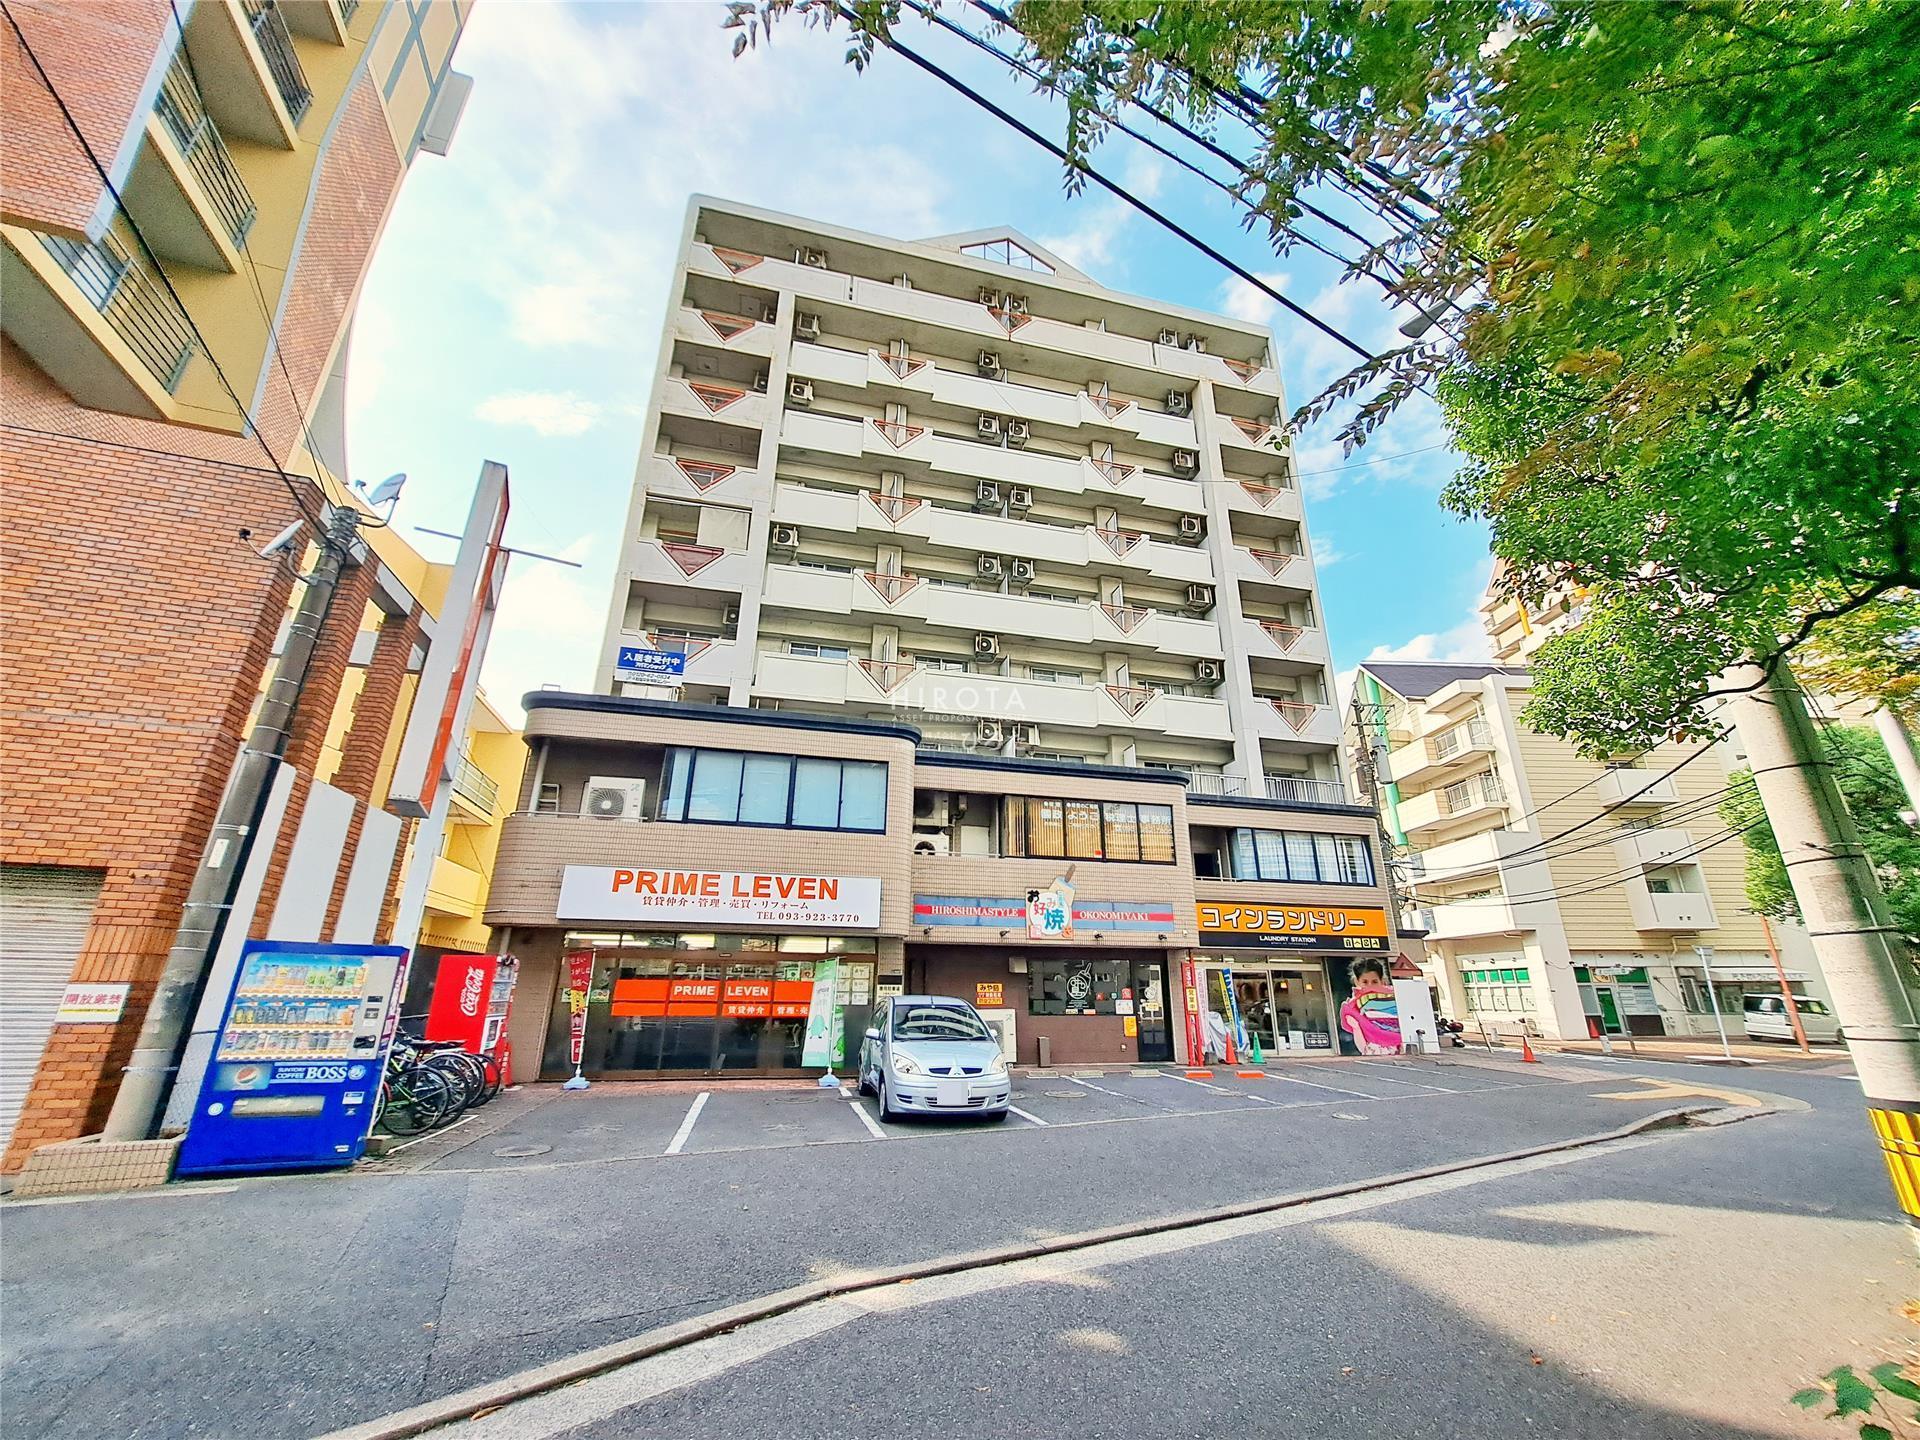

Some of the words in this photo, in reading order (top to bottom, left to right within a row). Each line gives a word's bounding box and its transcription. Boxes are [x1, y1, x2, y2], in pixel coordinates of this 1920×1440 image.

[624, 652, 681, 666] 入居者受付中
[611, 870, 721, 896] PRIME
[732, 875, 839, 900] LEVEN
[642, 895, 808, 910] 賃貸仲介・管理・売買・リフォーム
[757, 911, 775, 921] TEL
[778, 912, 860, 923] 093-923-3770
[931, 906, 1019, 918] HIROSHIMASTYLE
[1079, 911, 1149, 921] OKONOMIYAKI
[1201, 907, 1366, 932] コインランドリー
[674, 985, 715, 995] PRIME
[727, 986, 769, 996] LEVEN
[305, 1066, 348, 1080] BOSS
